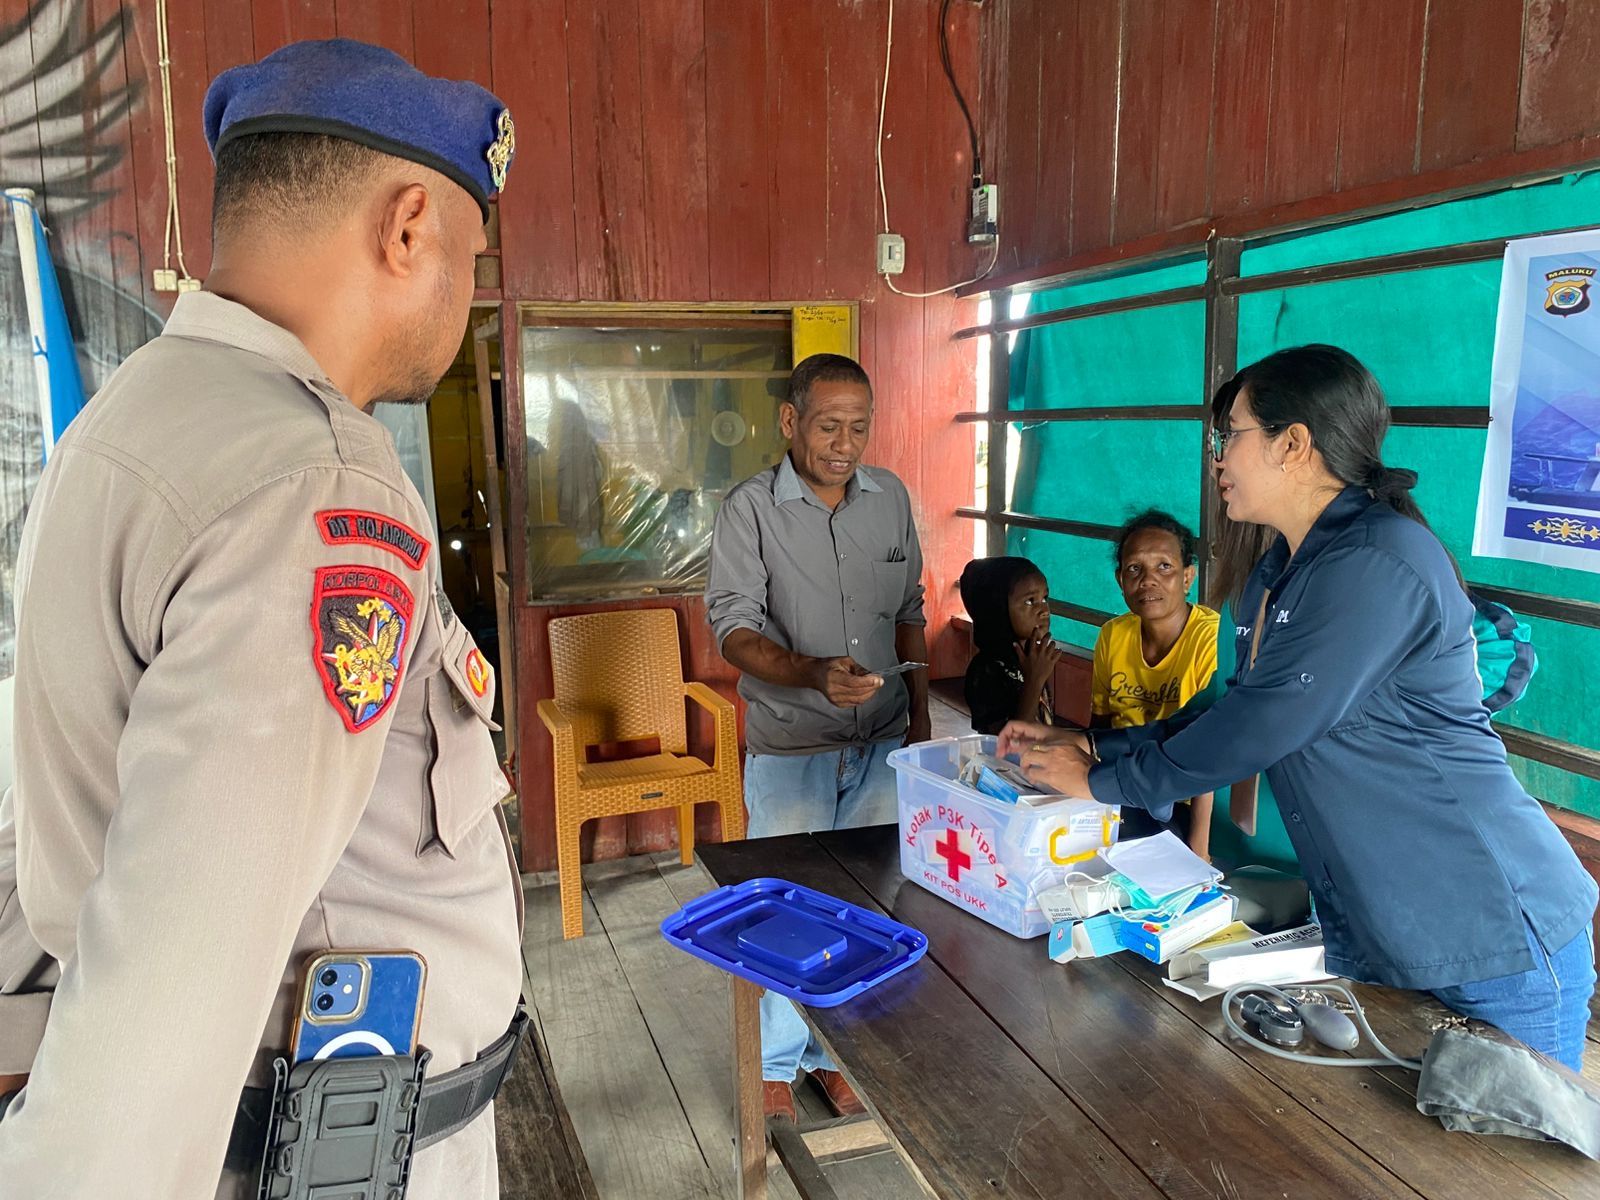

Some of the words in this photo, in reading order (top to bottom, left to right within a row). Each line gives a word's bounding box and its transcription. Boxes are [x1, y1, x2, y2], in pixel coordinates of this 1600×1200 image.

[1548, 269, 1592, 278] MALUKU
[905, 806, 933, 848] Kotak
[937, 804, 965, 830] P3K
[970, 822, 997, 865] Tipe
[994, 873, 1008, 889] A
[923, 871, 939, 885] KIT
[941, 880, 961, 898] POS
[963, 893, 988, 911] UKK
[1252, 932, 1300, 948] MEFENAMIC
